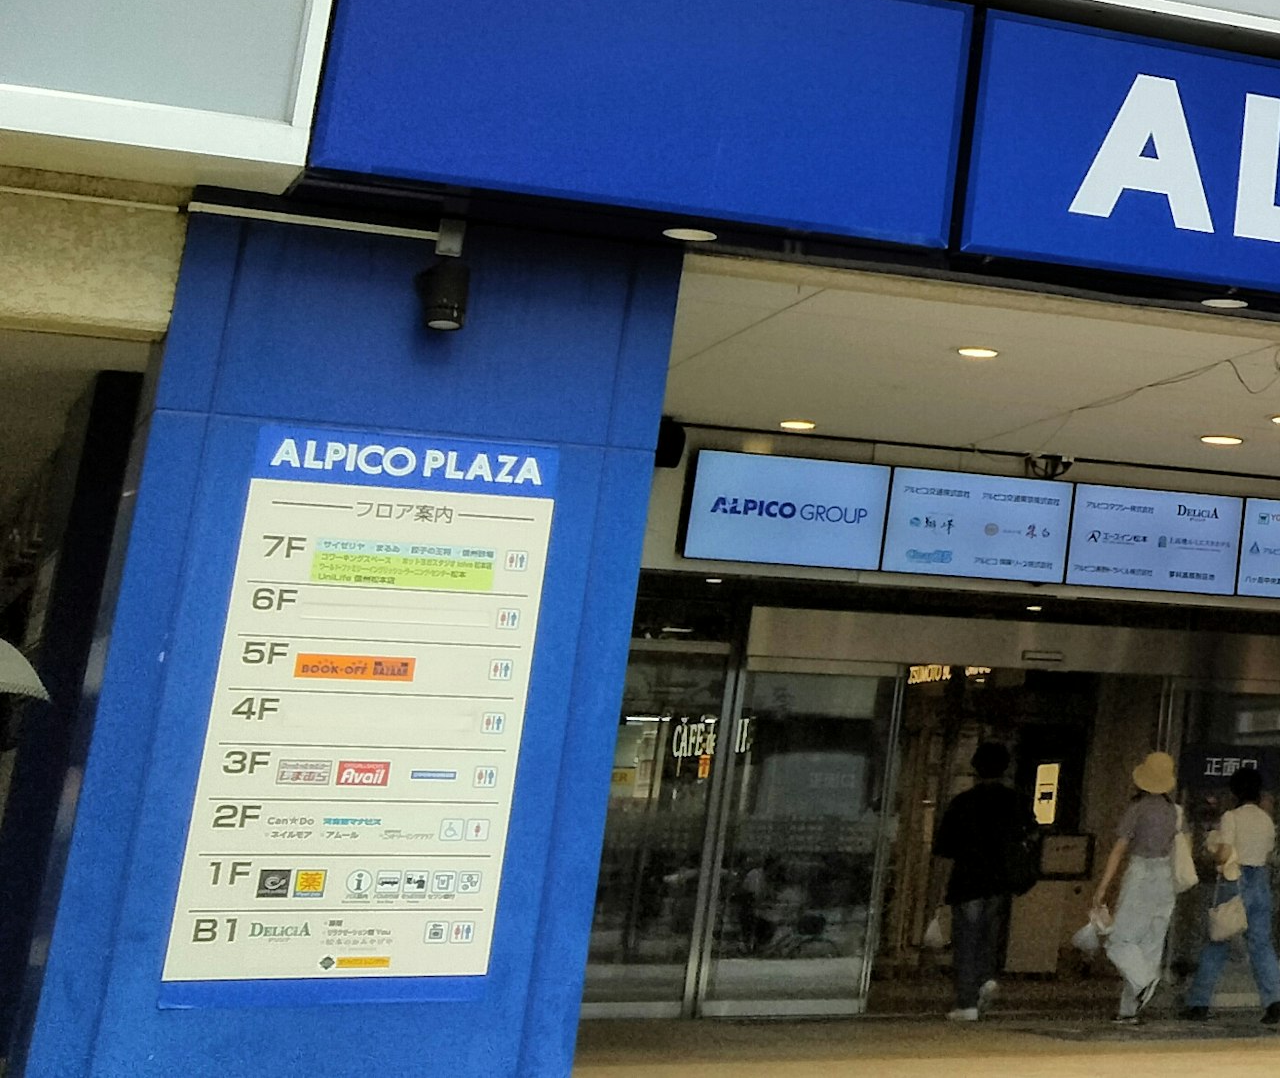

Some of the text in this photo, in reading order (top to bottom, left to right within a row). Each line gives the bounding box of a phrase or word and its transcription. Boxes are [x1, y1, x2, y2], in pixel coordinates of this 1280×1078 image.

[270, 438, 542, 485] ALPICO PLAZA
[356, 501, 454, 524] フロア案内
[710, 496, 868, 524] ALPICO GROUP
[262, 534, 307, 558] 7F
[324, 541, 365, 550] サイゼリヤ
[252, 588, 298, 612] 6F
[242, 642, 289, 665] 5F
[232, 697, 280, 721] 4F
[222, 751, 271, 774] 3F
[340, 769, 385, 785] Avail
[212, 804, 262, 829] 2F
[208, 861, 253, 886] 1F
[192, 918, 238, 943] B1
